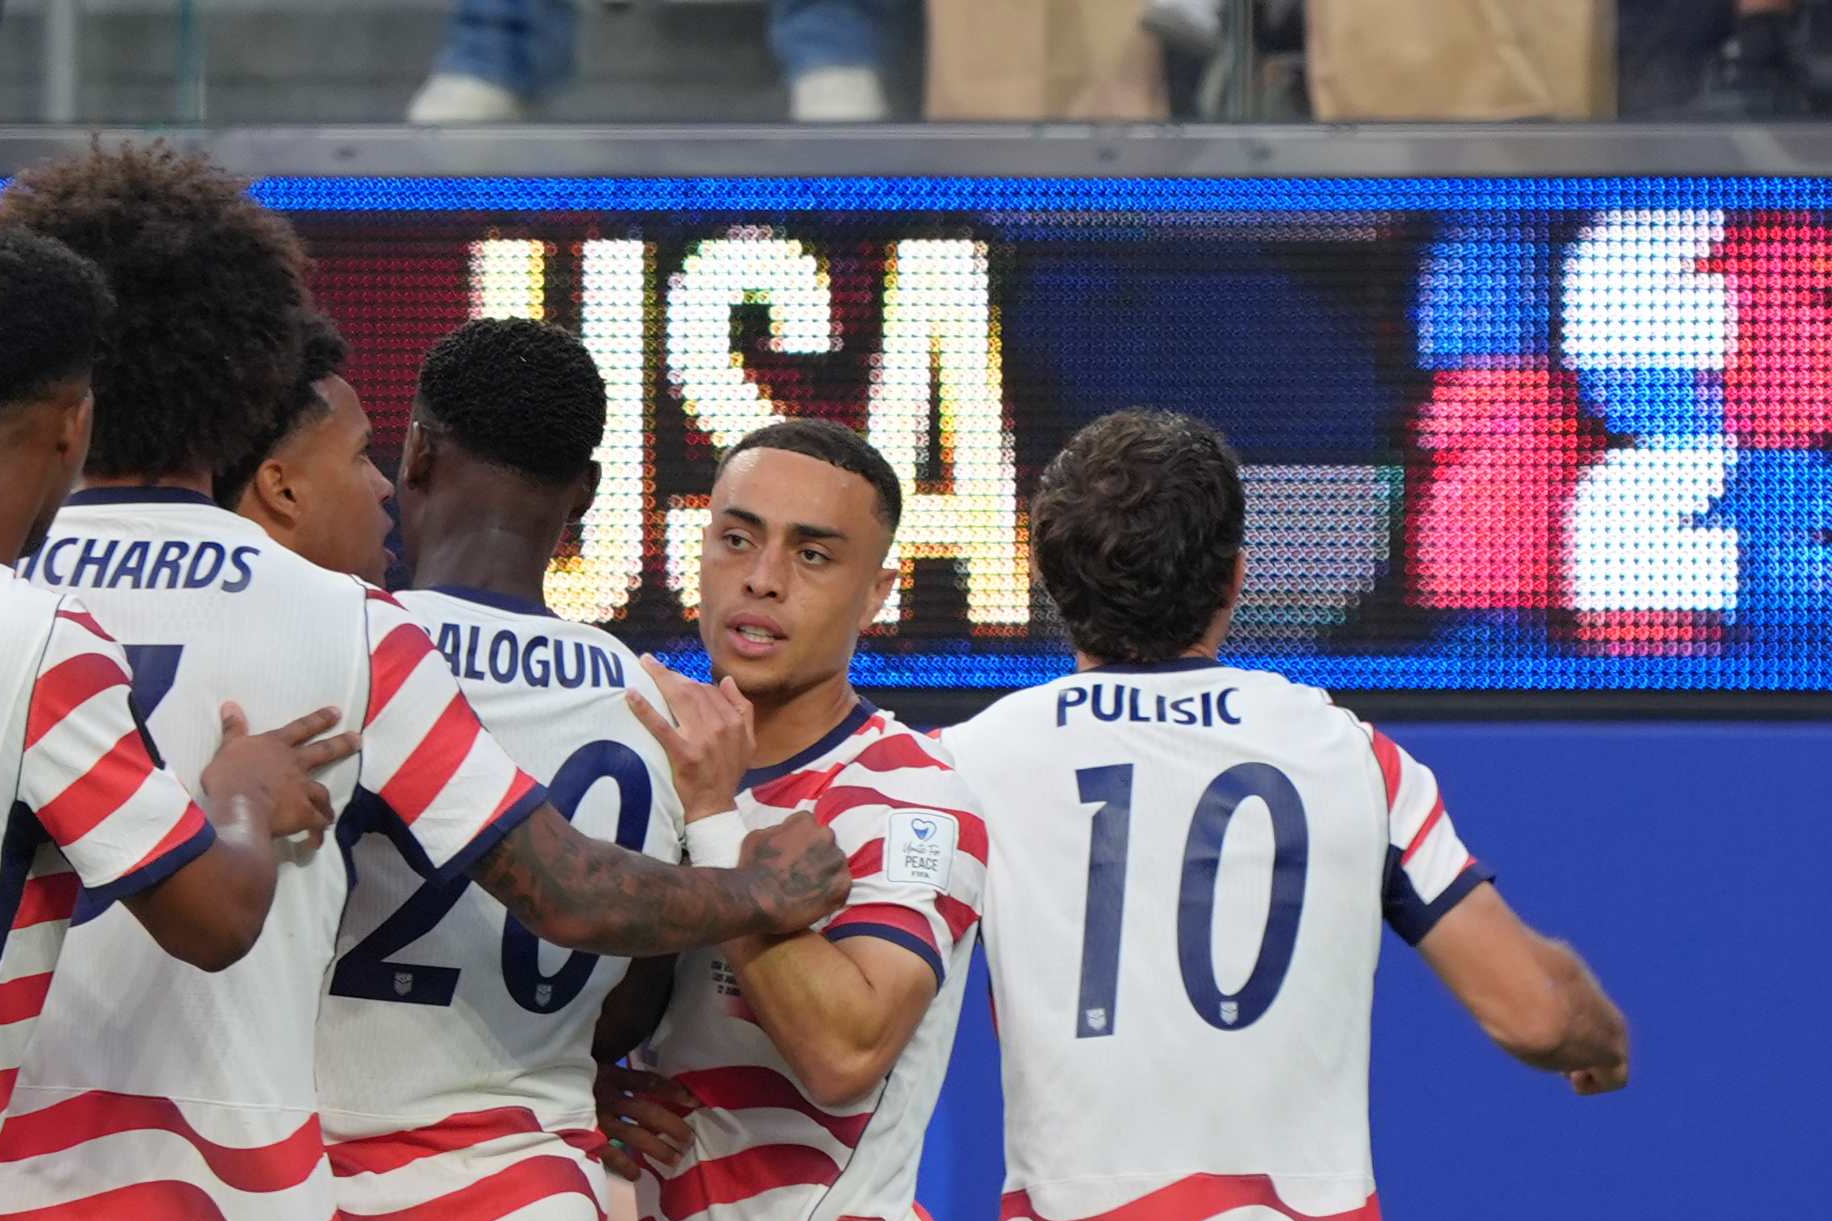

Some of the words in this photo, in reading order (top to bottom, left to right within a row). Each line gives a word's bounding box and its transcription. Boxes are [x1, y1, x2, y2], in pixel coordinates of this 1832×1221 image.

[468, 228, 1030, 626] USA
[14, 536, 261, 593] ICHARDS
[424, 622, 625, 688] ALOGUN
[1057, 684, 1242, 728] PULISIC
[905, 855, 938, 872] PEACE
[1075, 762, 1309, 1038] 10
